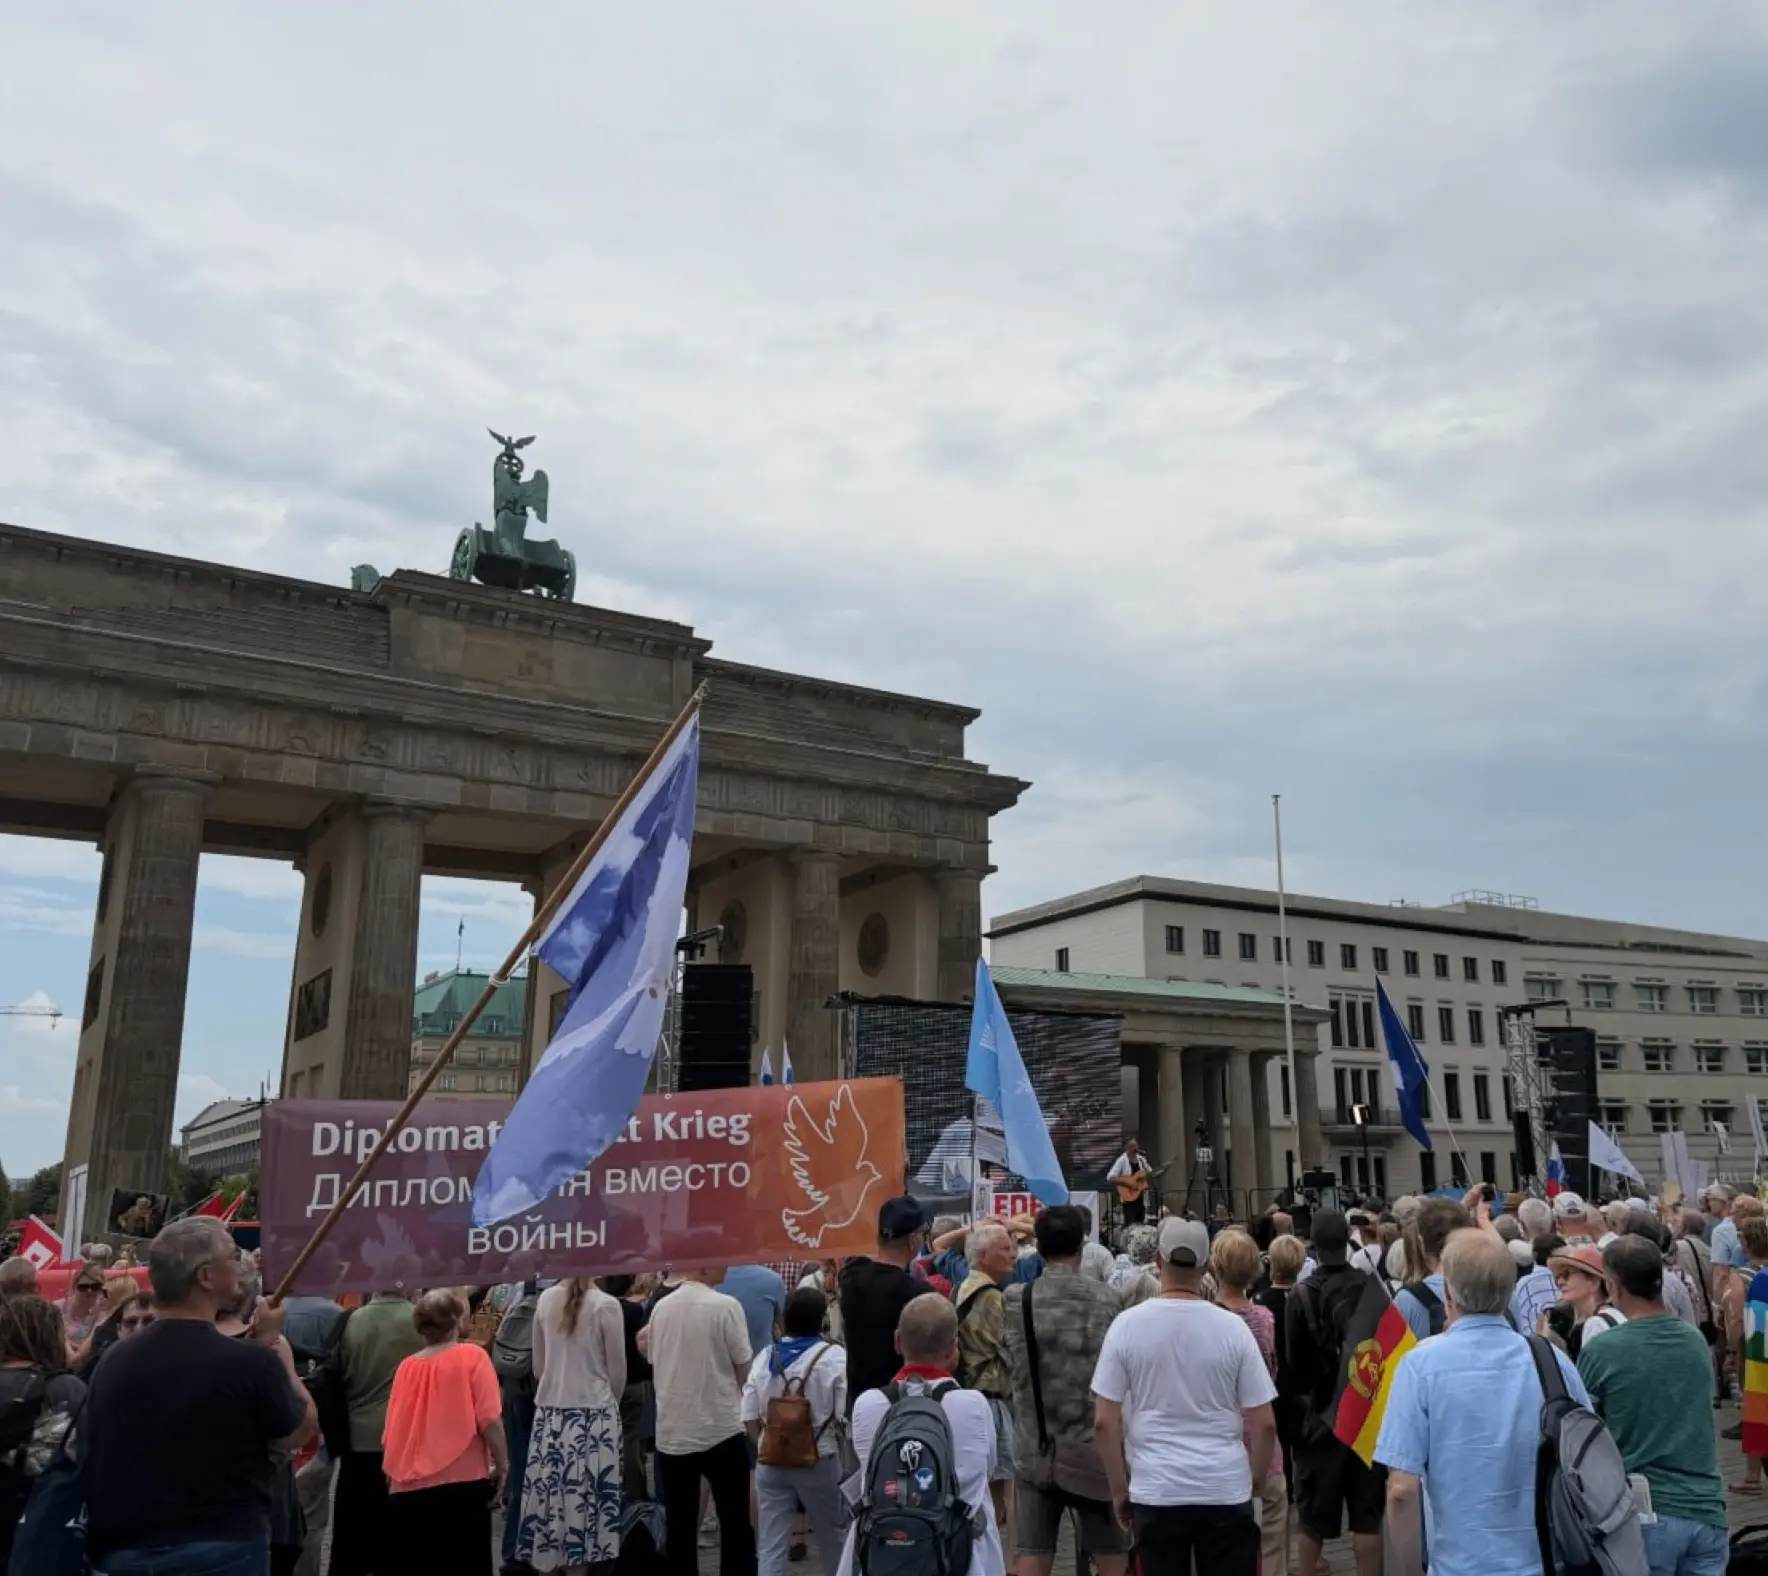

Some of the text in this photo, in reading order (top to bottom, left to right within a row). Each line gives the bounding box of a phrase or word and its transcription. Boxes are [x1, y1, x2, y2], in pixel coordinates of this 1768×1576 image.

[311, 1118, 507, 1165] Diplomat
[653, 1109, 752, 1146] Krieg
[306, 1160, 751, 1218] Дипломя вместо
[467, 1214, 606, 1255] войны
